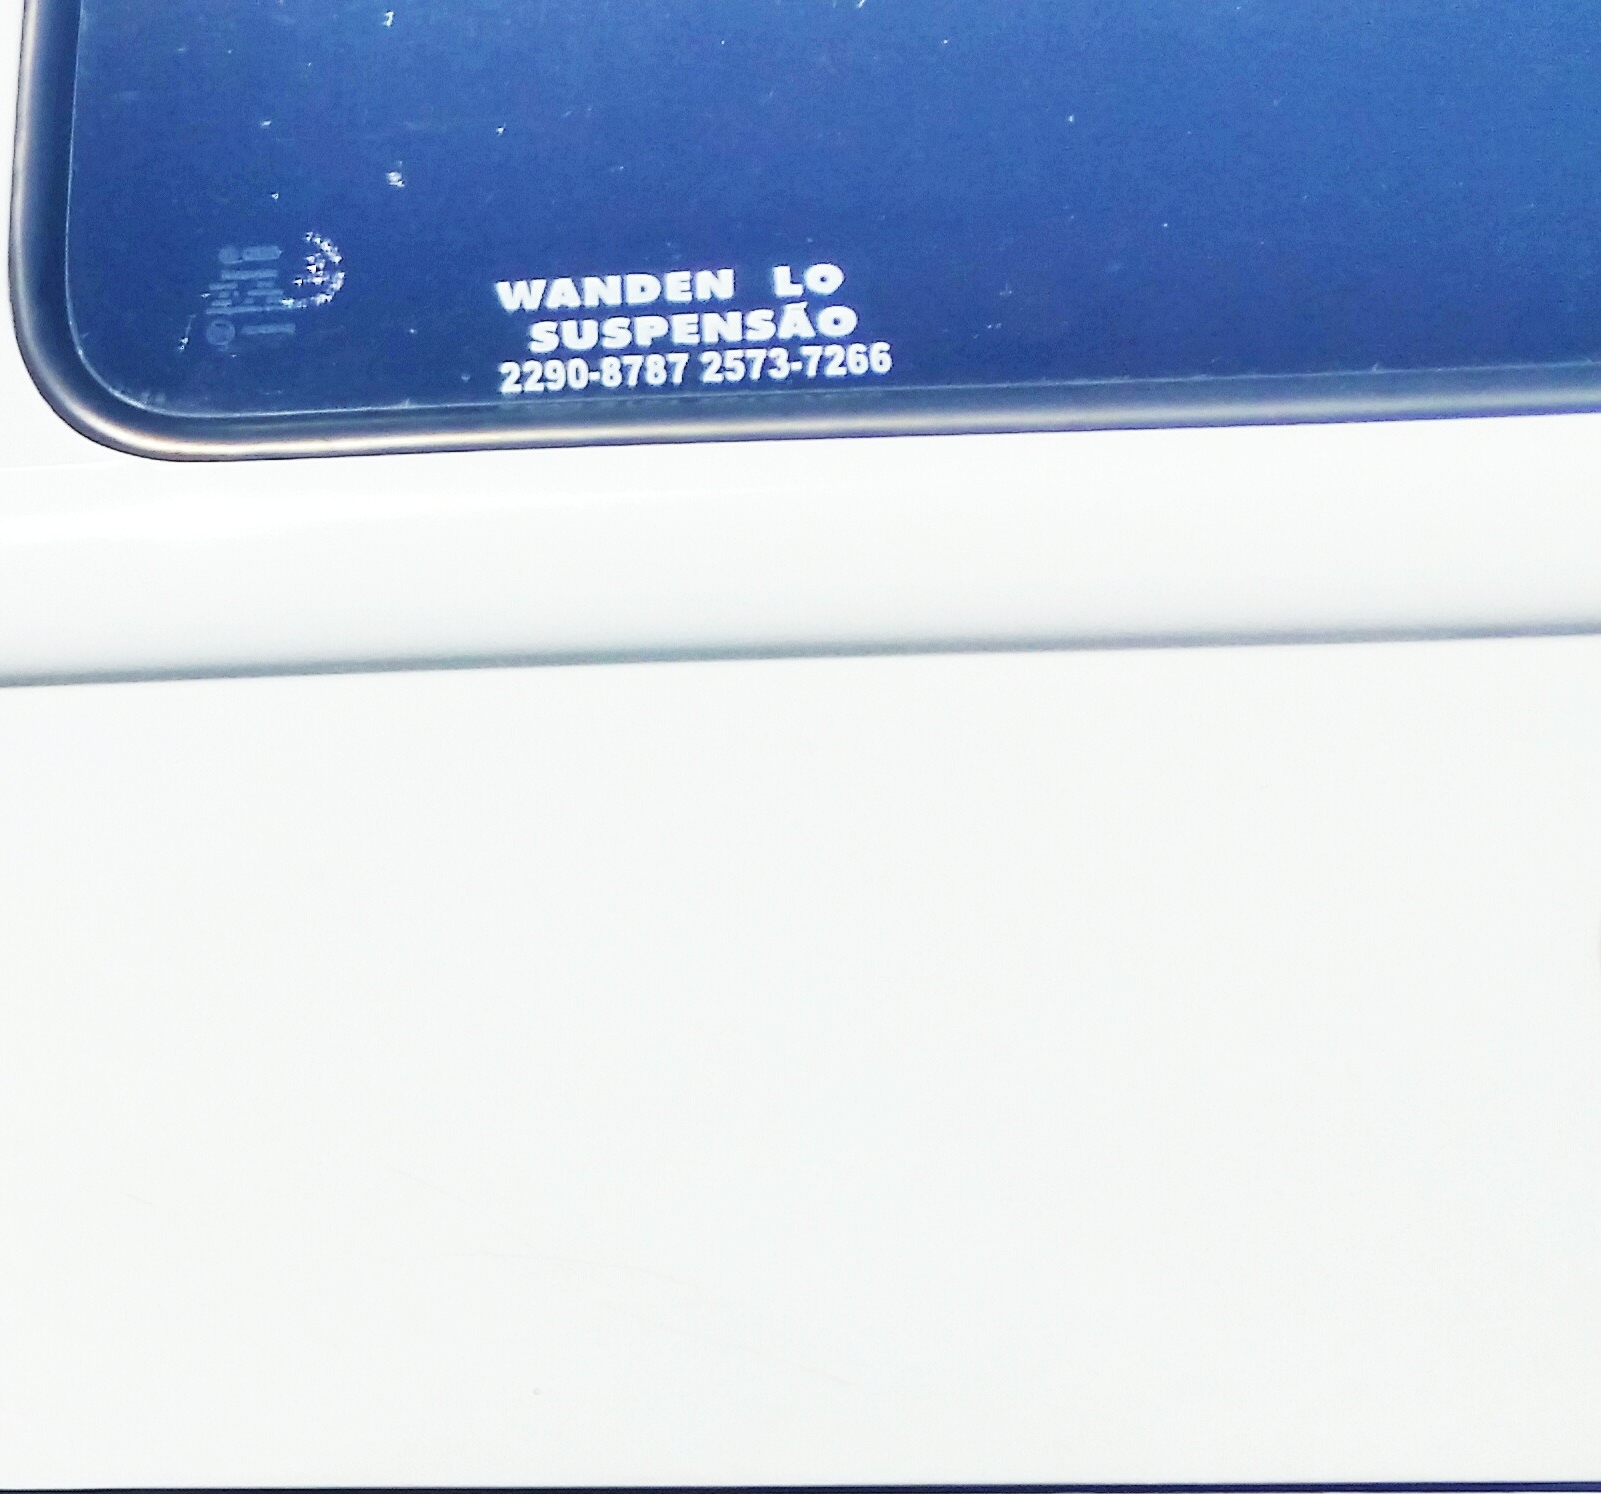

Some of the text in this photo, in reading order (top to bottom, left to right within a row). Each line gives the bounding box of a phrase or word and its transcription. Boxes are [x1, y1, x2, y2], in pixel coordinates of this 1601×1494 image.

[496, 263, 846, 313] WANDEN LO
[528, 300, 859, 354] SUSPENSÃO
[498, 343, 893, 395] 2290-8787 2573-7266
